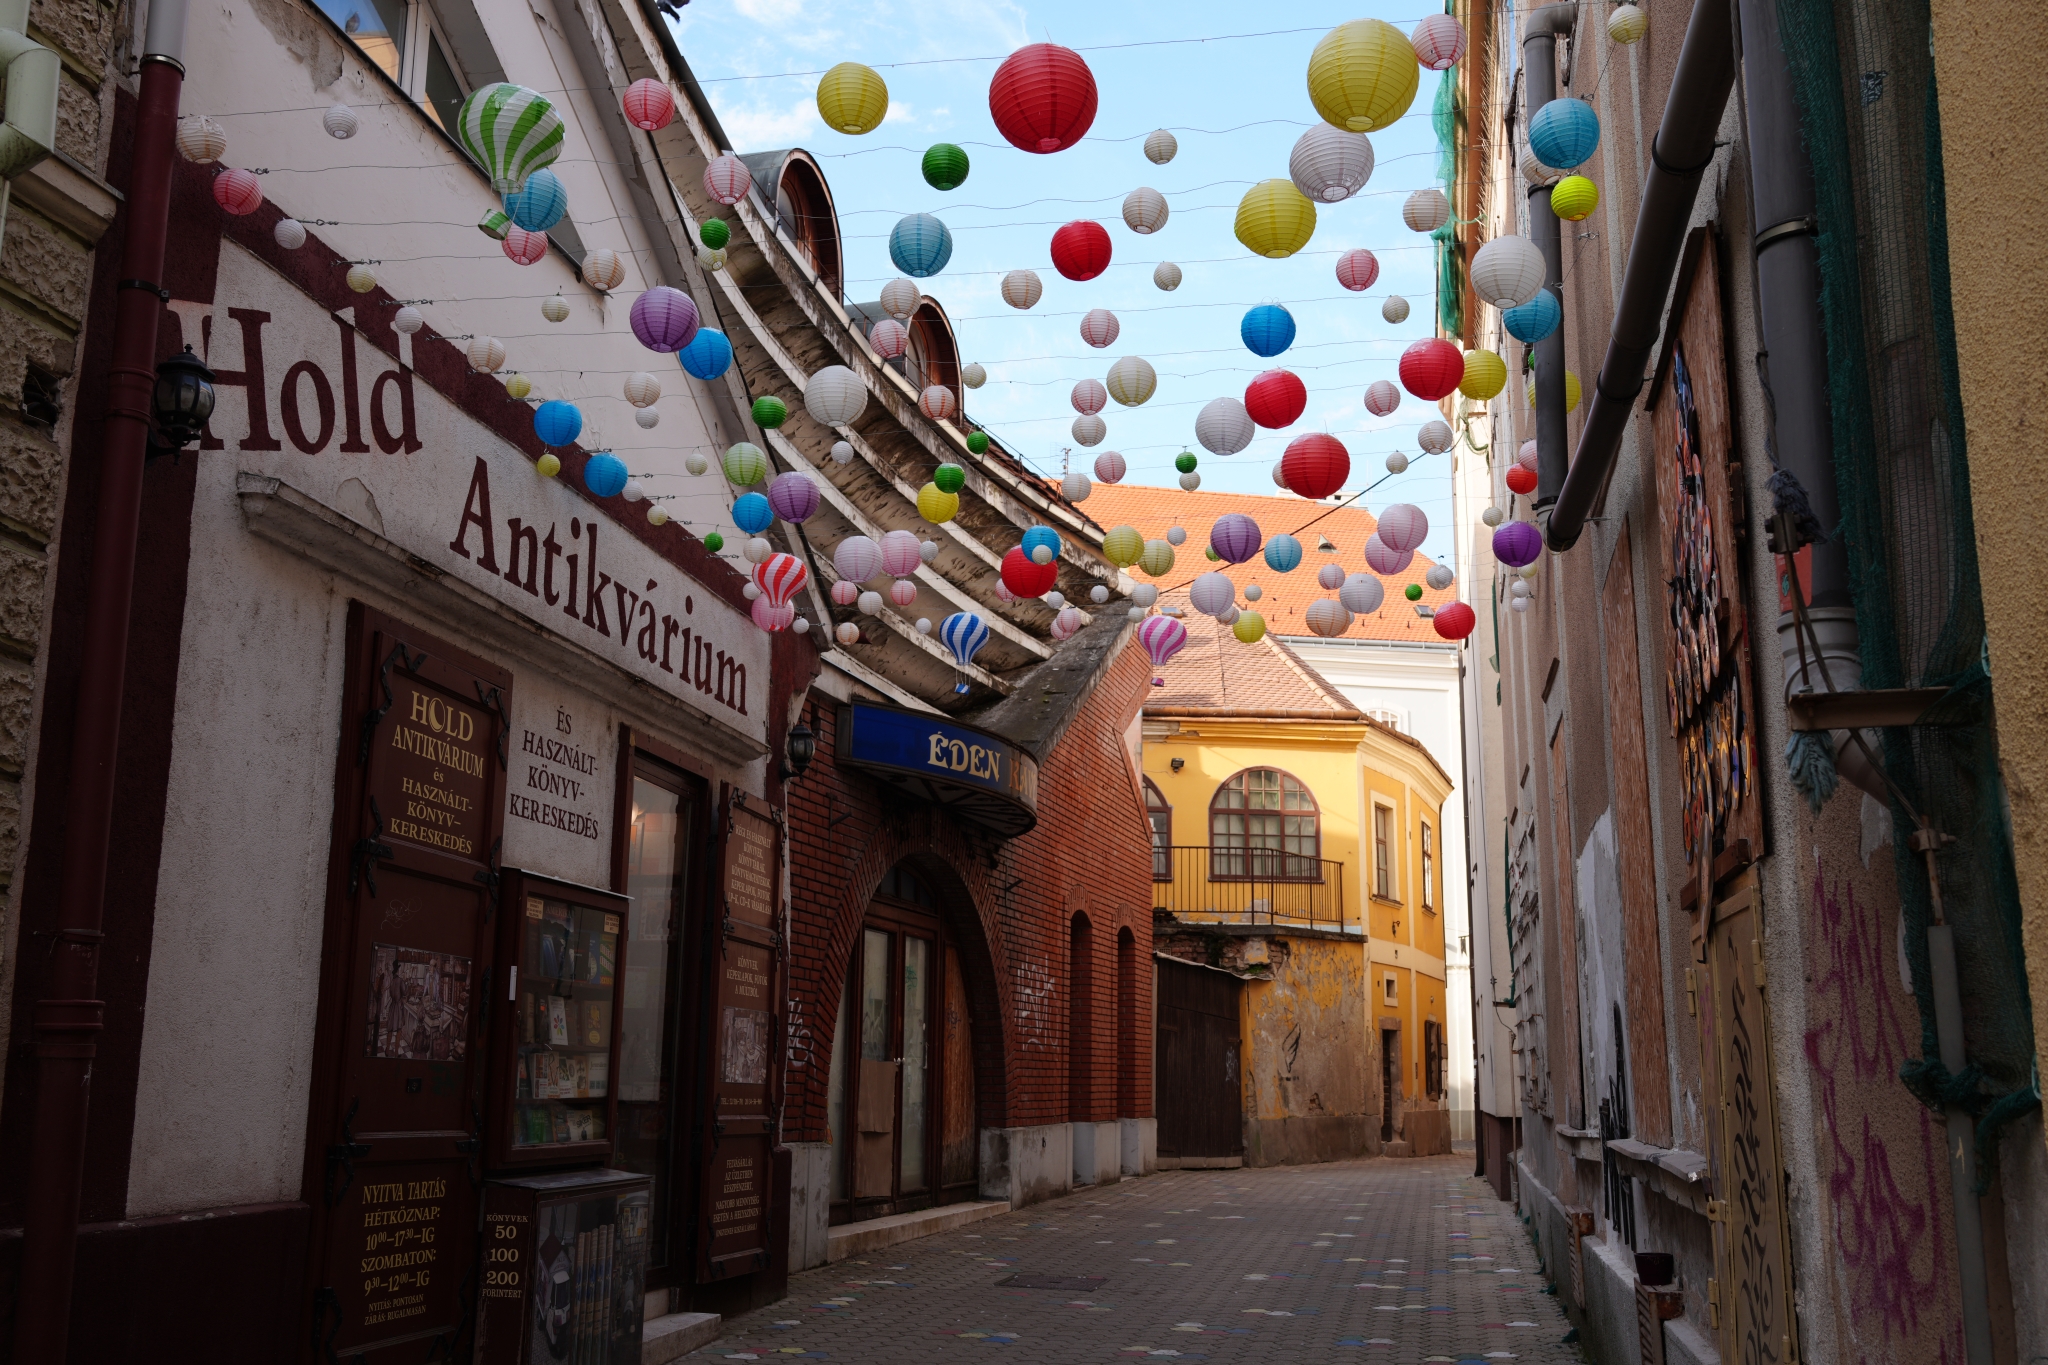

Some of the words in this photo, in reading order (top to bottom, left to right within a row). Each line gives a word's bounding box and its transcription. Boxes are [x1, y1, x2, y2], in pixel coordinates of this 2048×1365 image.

[167, 298, 423, 455] Hold
[450, 456, 749, 717] Antikvárium
[410, 690, 474, 741] HOLD
[556, 705, 571, 734] ÉS
[391, 724, 484, 779] ANTIKVÁRIUM
[522, 729, 598, 776] HASZNÁLT-
[927, 731, 1001, 783] ÉDEN
[433, 767, 444, 782] és
[527, 763, 585, 801] KÖNYV-
[402, 777, 473, 812] HASZNÁLT-
[509, 793, 599, 840] KERESKEDÉS
[390, 817, 474, 855] KERESKEDÉS
[362, 1183, 404, 1205] NYITVA
[407, 1177, 446, 1200] TARTÁS
[364, 1205, 441, 1228] HÉTKÖZNAP:
[486, 1212, 529, 1223] KÖNYVEK
[495, 1225, 517, 1239] 50
[360, 1248, 437, 1273] SZOMBATON:
[489, 1248, 519, 1262] 100
[486, 1270, 519, 1285] 200
[368, 1298, 392, 1312] NYITÁS:
[392, 1293, 424, 1308] PONTOSAN
[482, 1287, 522, 1298] FORINTÉRT
[364, 1311, 386, 1326] ZÁRÁS:
[387, 1304, 427, 1321] RUGALMASAN
